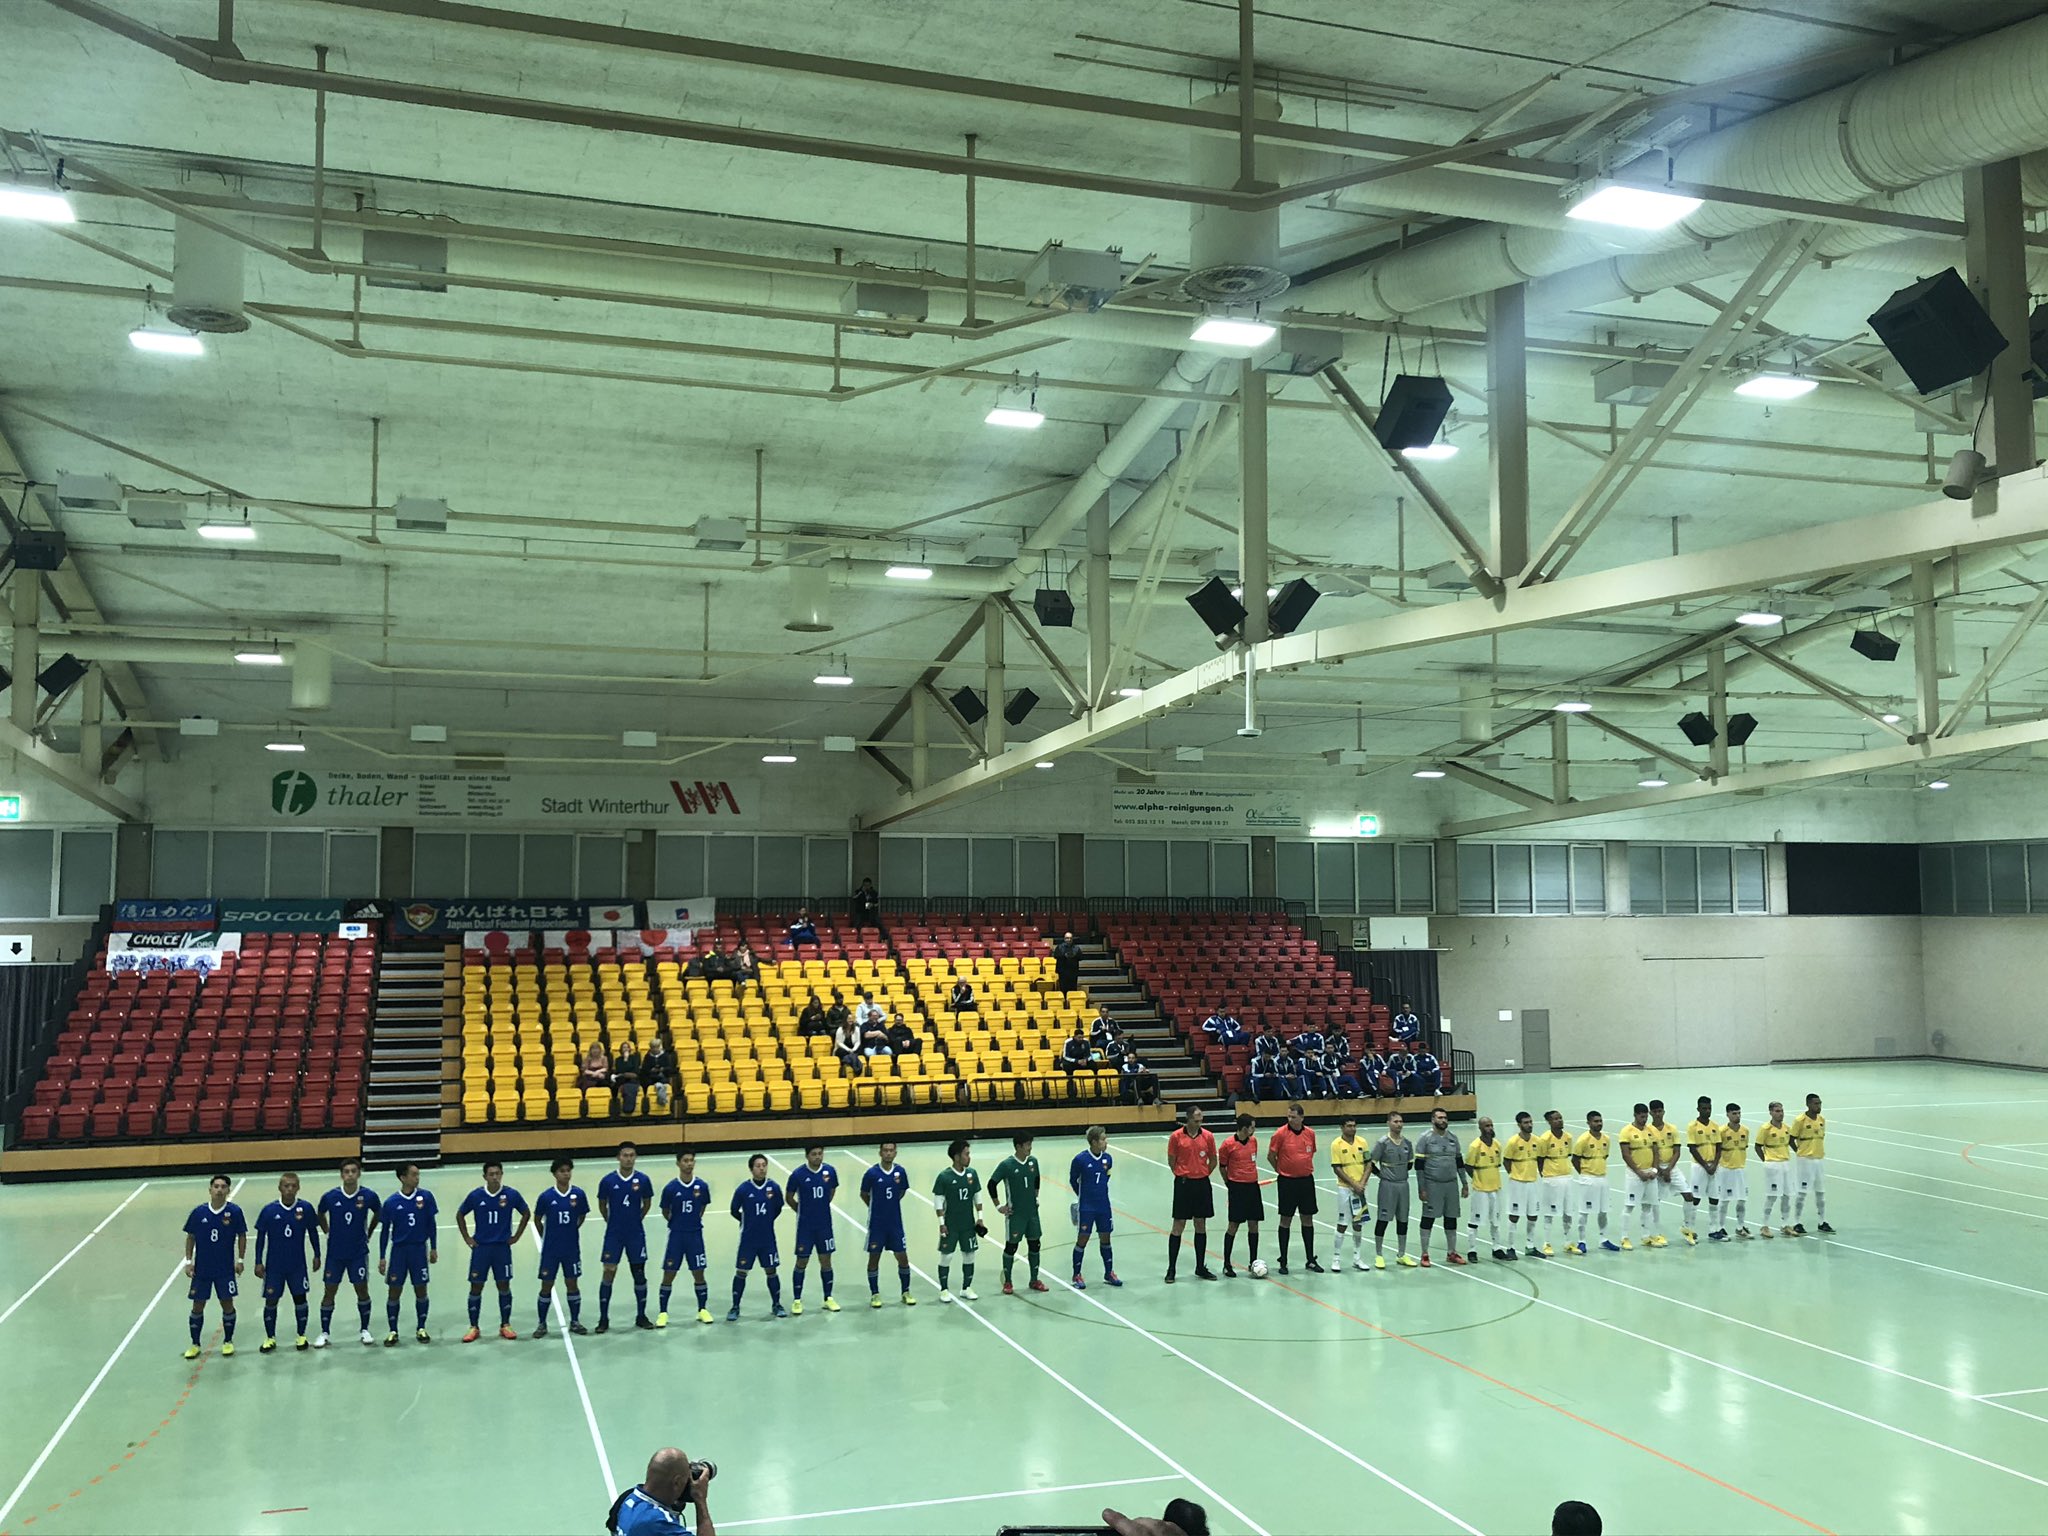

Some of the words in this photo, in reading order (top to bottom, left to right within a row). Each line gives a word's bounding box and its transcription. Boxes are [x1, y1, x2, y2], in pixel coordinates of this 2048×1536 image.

[327, 785, 408, 806] thaler
[1146, 788, 1165, 796] Jahre
[541, 797, 583, 814] Stadt
[588, 798, 670, 815] Winterthur
[1113, 803, 1234, 814] www.alpha-reinigungen.ch
[222, 909, 342, 922] SPOCOLLA
[447, 919, 473, 930] Japan
[474, 919, 494, 929] Deaf
[496, 919, 530, 929] Football
[531, 919, 579, 929] Association
[133, 934, 181, 946] CHOICE
[1023, 1176, 1029, 1189] 1
[1095, 1172, 1101, 1184] 7
[812, 1186, 824, 1199] 10
[886, 1187, 893, 1199] 5
[959, 1187, 969, 1201] 12
[622, 1194, 631, 1207] 4
[682, 1200, 693, 1213] 15
[755, 1203, 767, 1216] 14
[344, 1211, 353, 1225] 9
[408, 1213, 416, 1227] 3
[488, 1211, 498, 1224] 11
[558, 1211, 570, 1224] 13
[210, 1228, 219, 1242] 8
[284, 1223, 292, 1238] 6
[824, 1237, 835, 1250] 10
[695, 1254, 706, 1267] 15
[769, 1252, 779, 1266] 14
[358, 1267, 366, 1280] 9
[421, 1268, 429, 1281] 3
[228, 1280, 236, 1295] 8
[303, 1276, 309, 1290] 6
